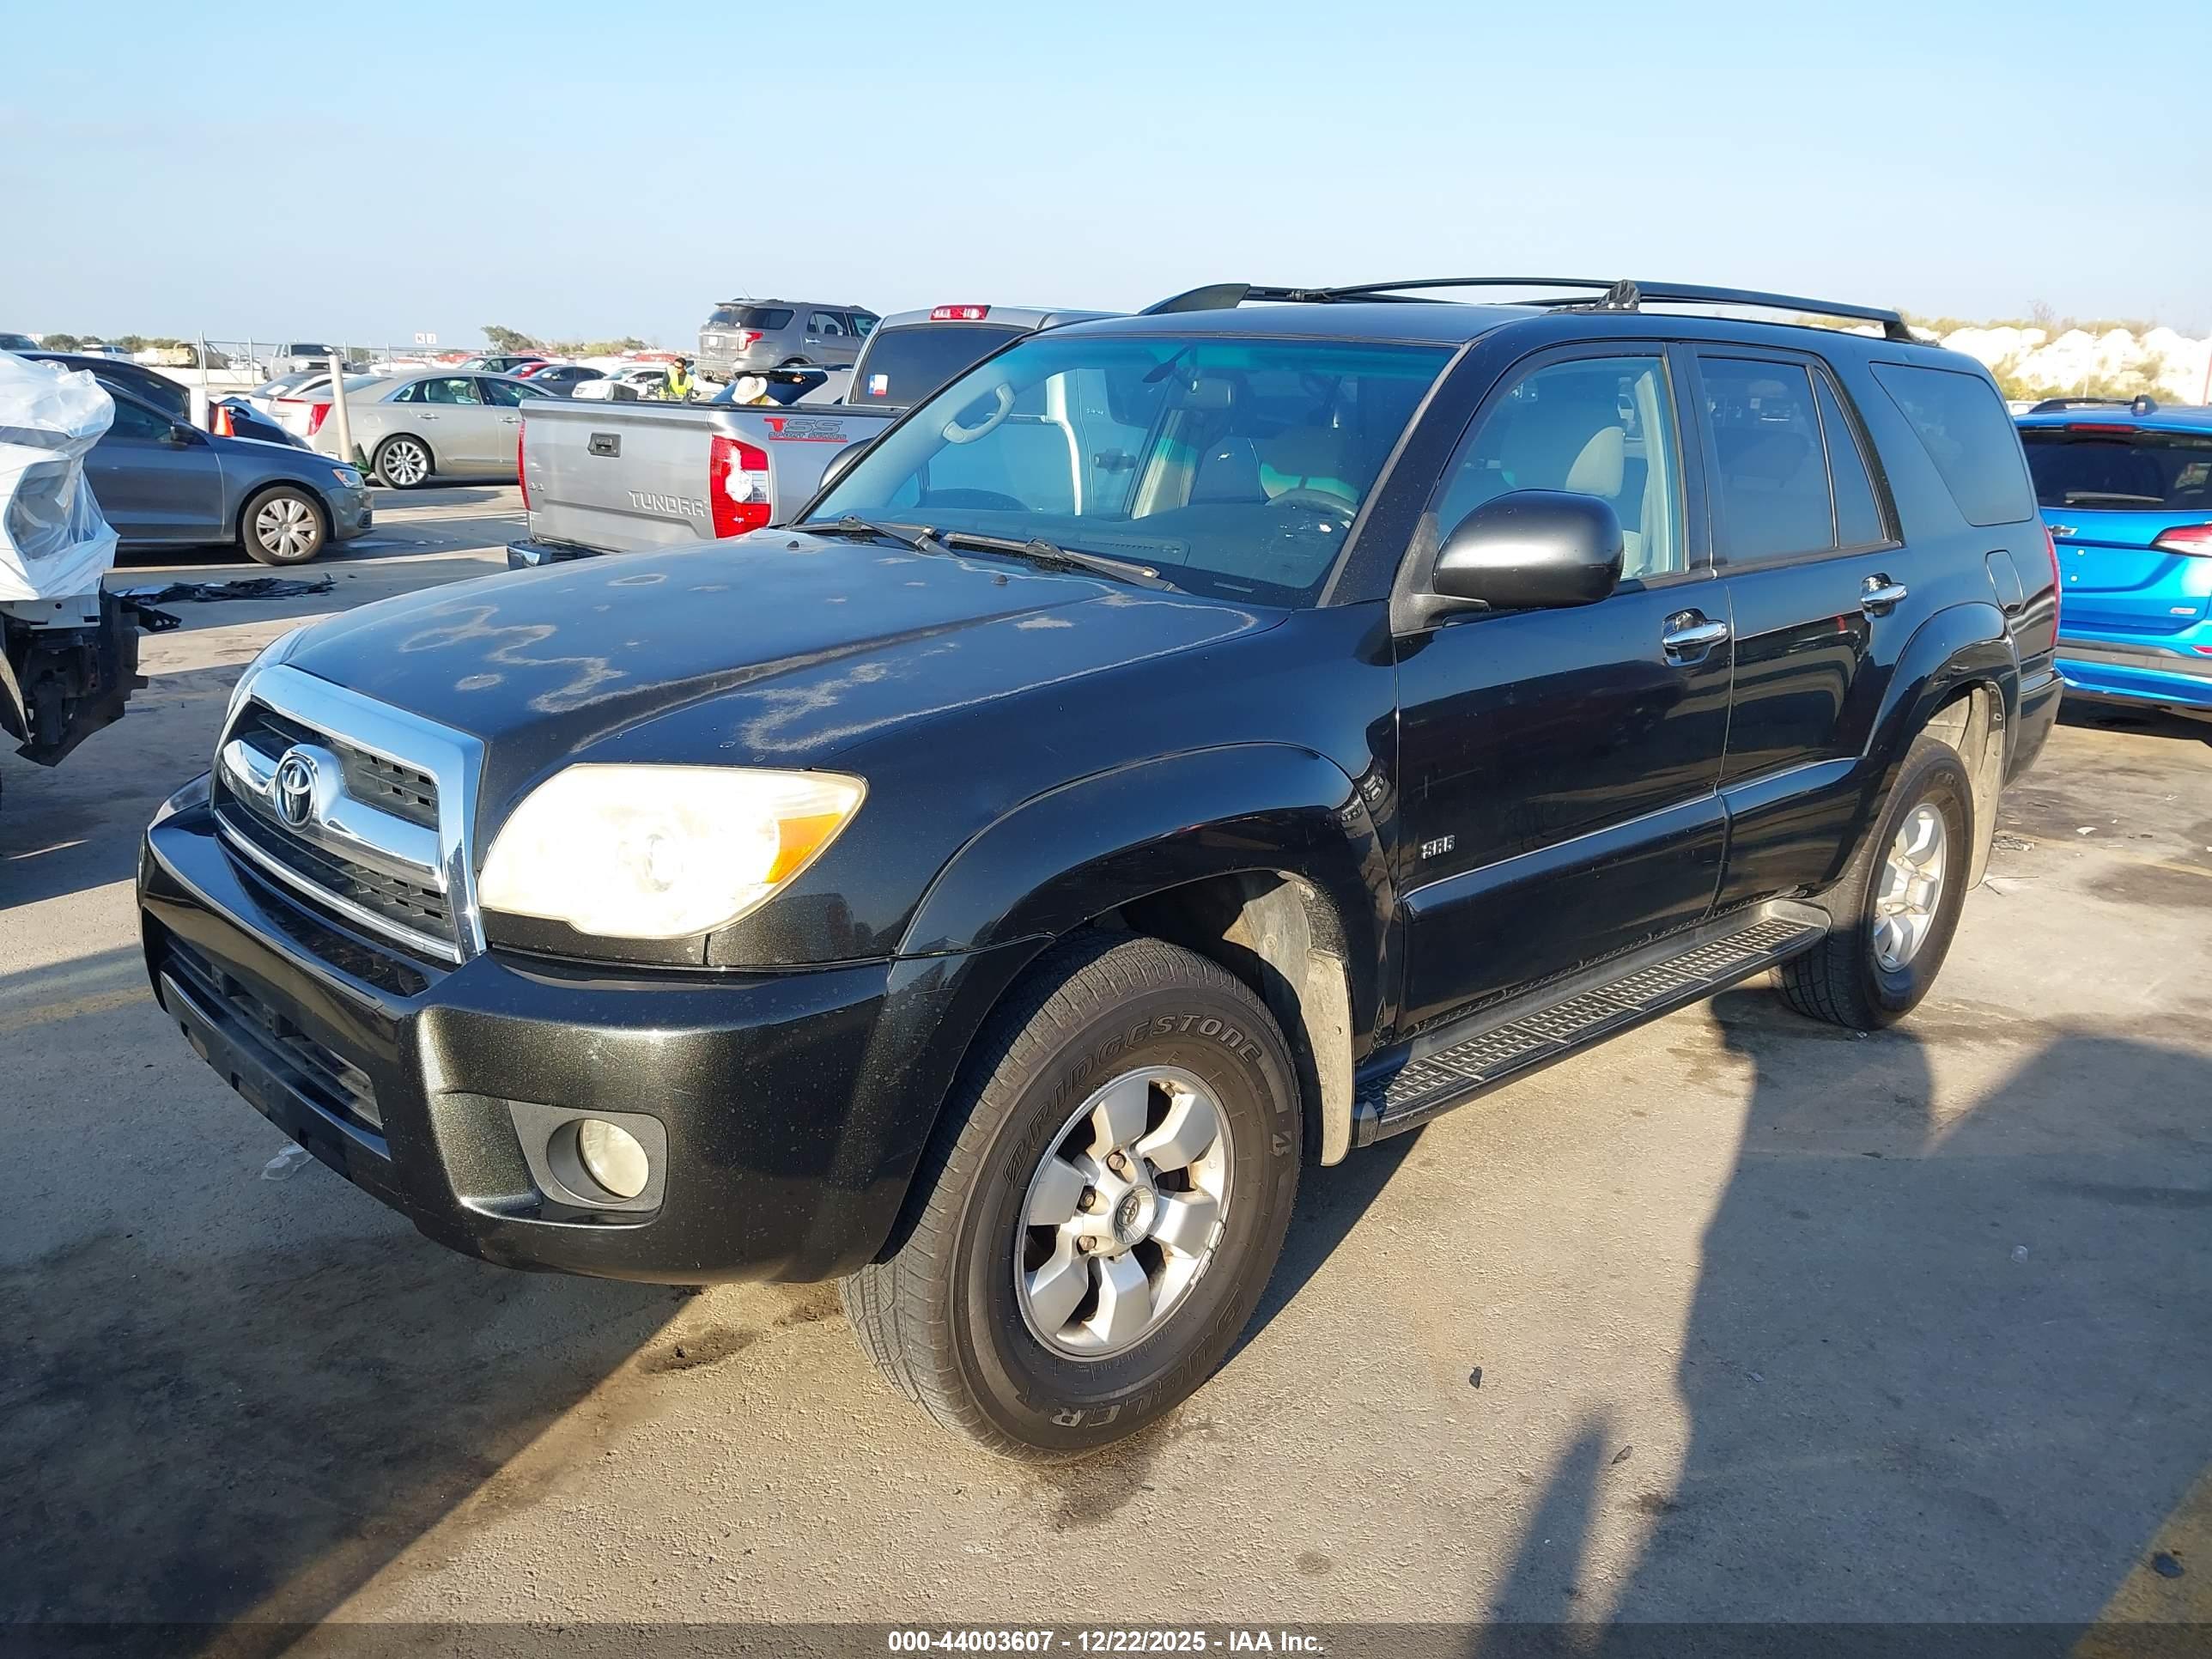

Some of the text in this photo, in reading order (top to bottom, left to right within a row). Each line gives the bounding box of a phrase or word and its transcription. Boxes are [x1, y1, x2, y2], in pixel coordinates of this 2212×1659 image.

[763, 417, 843, 434] TSS
[627, 489, 706, 517] TUNDRA
[1002, 1010, 1263, 1189] BRIDGESTONE
